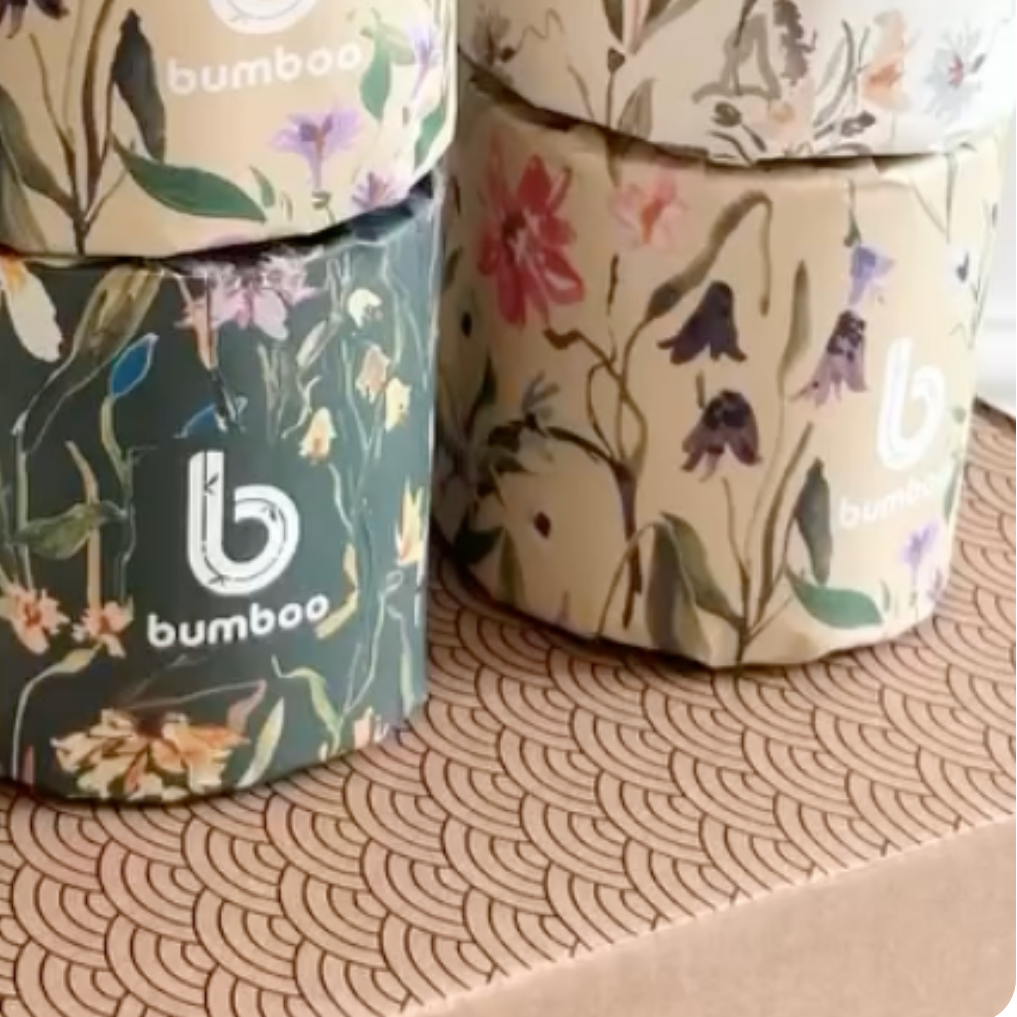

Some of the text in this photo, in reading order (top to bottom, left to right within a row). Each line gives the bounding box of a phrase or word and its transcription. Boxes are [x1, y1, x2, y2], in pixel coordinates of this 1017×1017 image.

[165, 42, 362, 96] bumboo
[187, 450, 300, 596] b
[146, 594, 330, 648] bumboo
